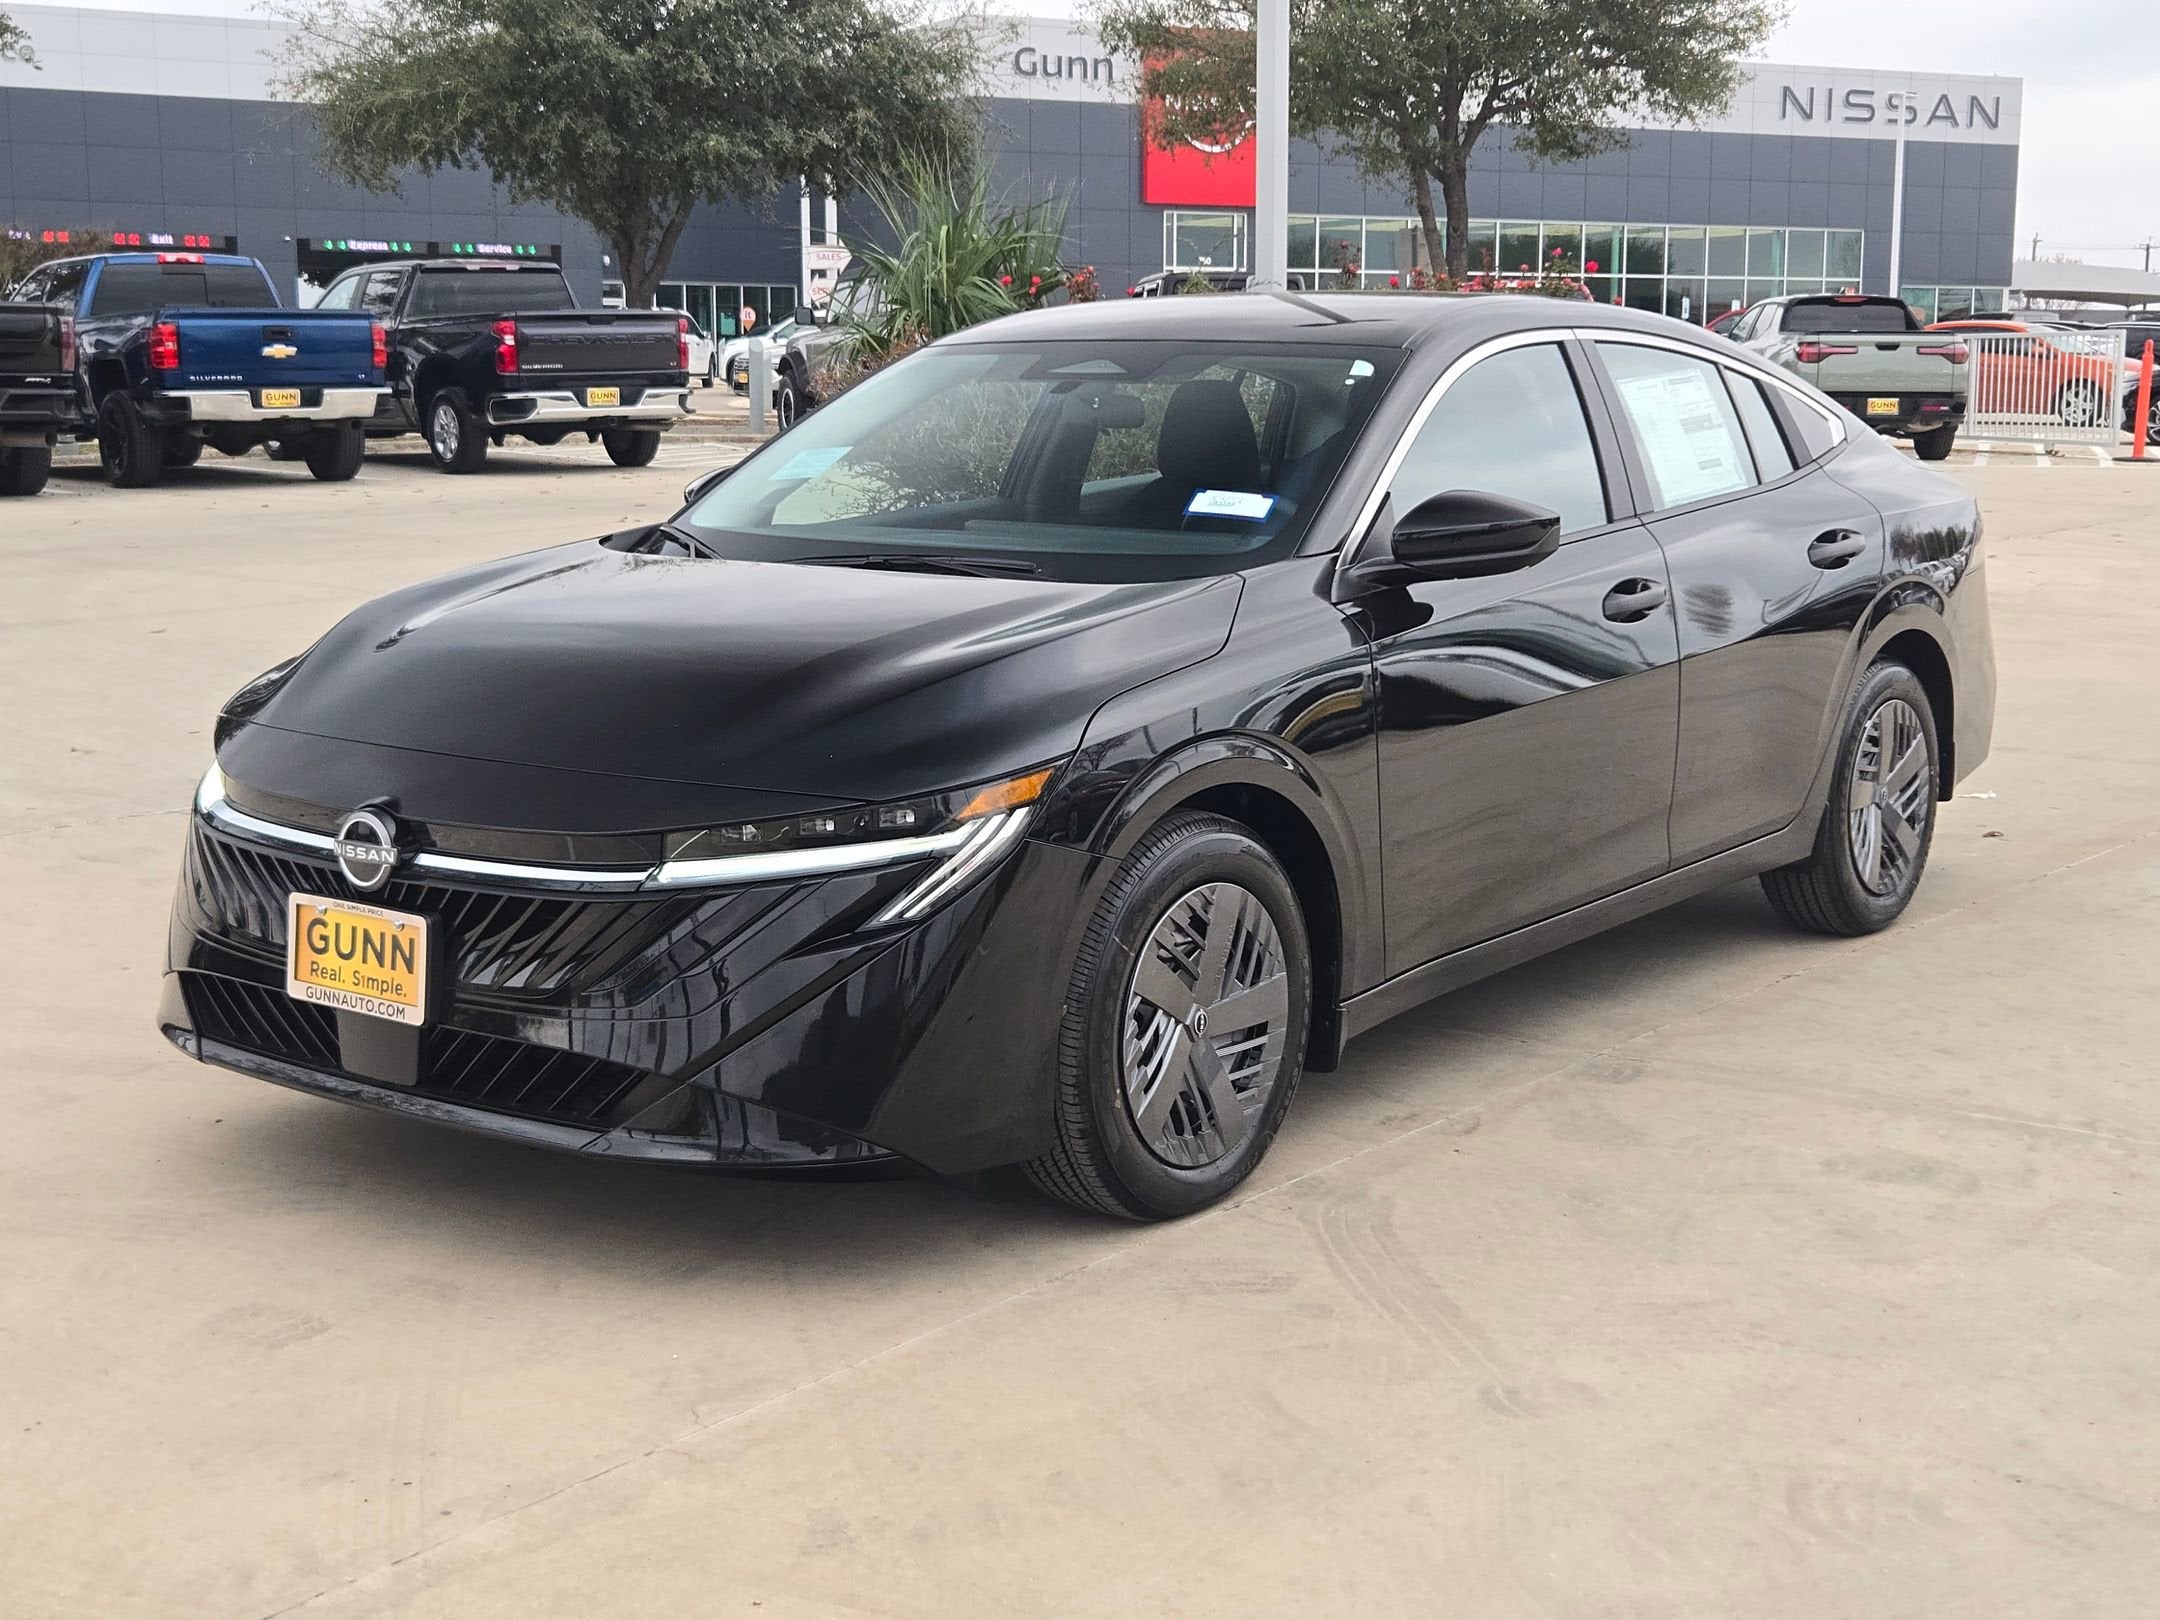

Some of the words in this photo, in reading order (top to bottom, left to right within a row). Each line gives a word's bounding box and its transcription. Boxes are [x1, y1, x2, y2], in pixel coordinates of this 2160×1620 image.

[1014, 47, 1114, 82] Gunn
[1779, 85, 2001, 130] NISSAN
[347, 240, 389, 252] Express
[477, 243, 512, 254] Service
[815, 253, 842, 261] SALES
[189, 374, 244, 382] SILVERADO
[265, 392, 297, 402] GUNN
[590, 391, 616, 400] GUNN
[1870, 401, 1896, 409] GUNN
[334, 841, 395, 863] NISSAN
[306, 917, 416, 975] GUNN
[310, 960, 346, 984] Real.
[305, 985, 406, 1021] GUNNAUTO.COM
